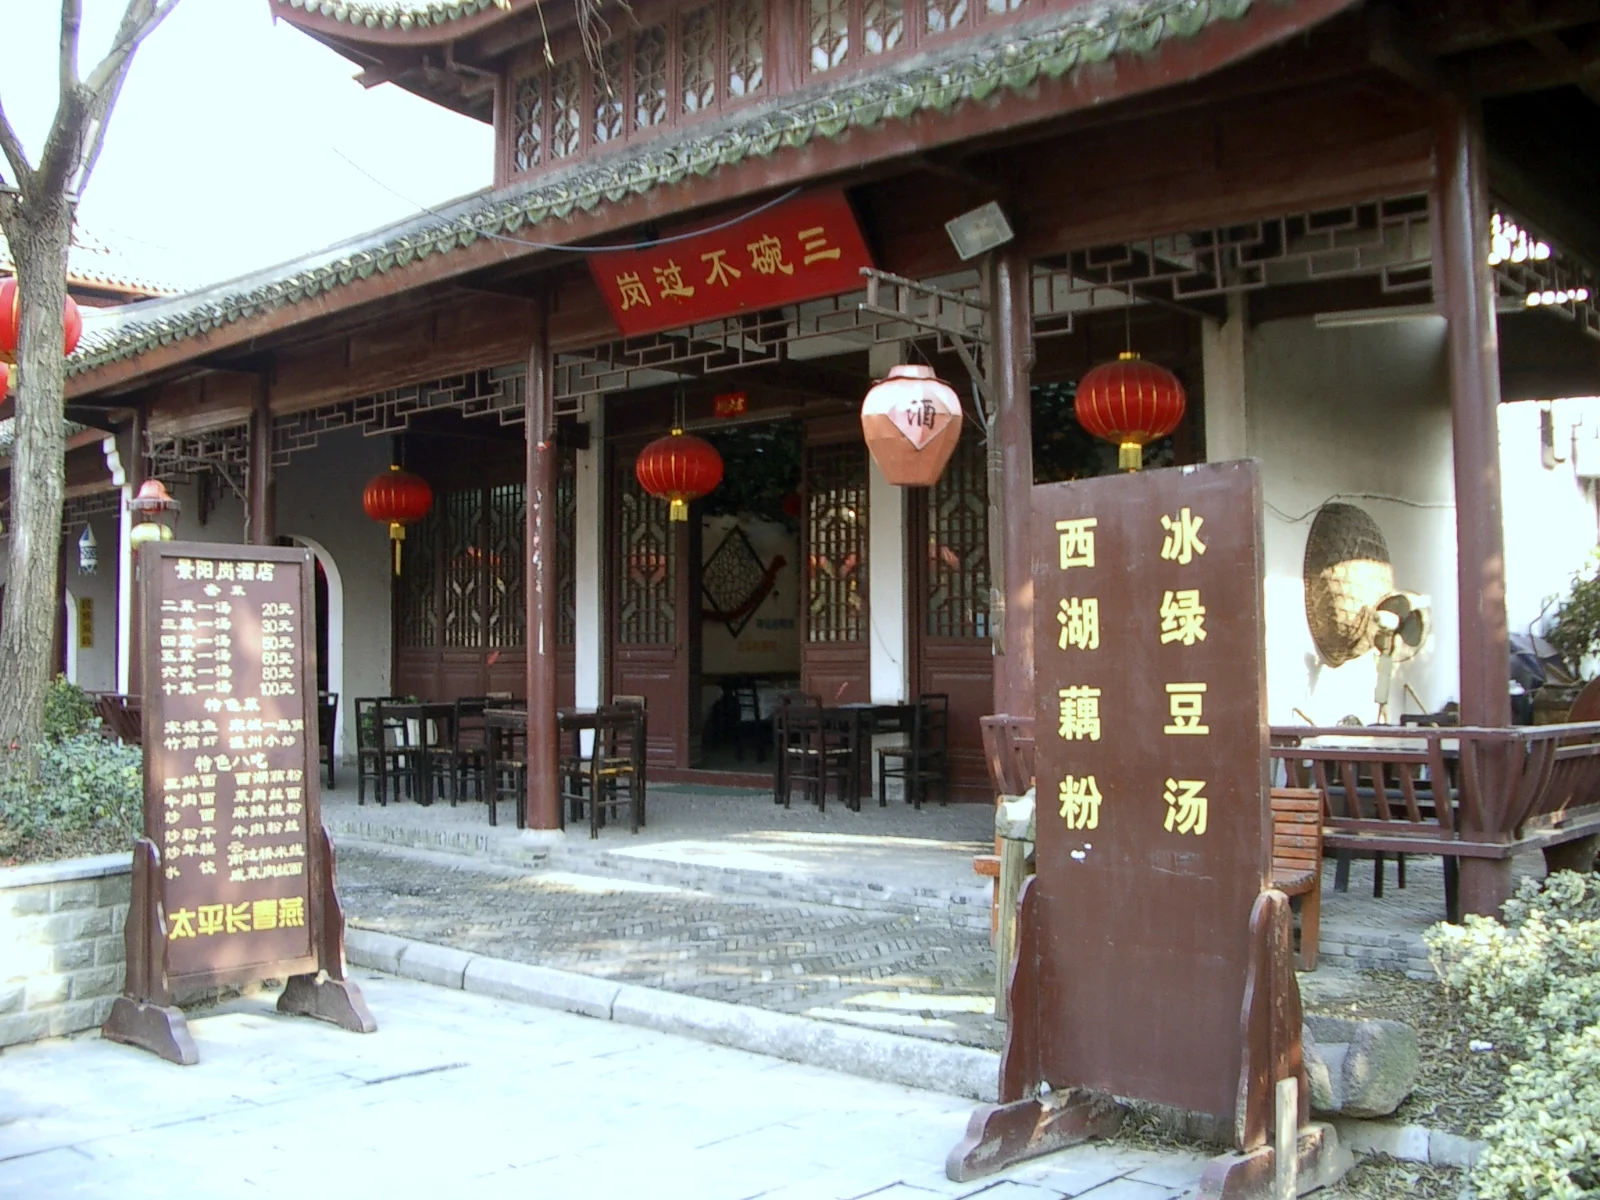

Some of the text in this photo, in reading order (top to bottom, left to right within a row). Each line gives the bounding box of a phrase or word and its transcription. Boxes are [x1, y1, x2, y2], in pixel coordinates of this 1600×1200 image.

[615, 226, 841, 310] 三碗不过岗
[906, 398, 936, 430] 酒
[174, 558, 276, 582] 景阳岗酒店
[160, 599, 295, 617] 二菜一汤 20元
[160, 616, 295, 634] 三菜一汤 30元
[160, 634, 232, 648] 四菜一汤
[160, 649, 295, 666] 五菜一汤 60元
[161, 664, 295, 681] 六菜一汤 80元
[1055, 517, 1103, 830] 西湖藕粉
[1159, 507, 1210, 835] 冰绿豆汤
[161, 680, 296, 697] 十菜一汤 100元
[203, 697, 261, 713] 特色菜
[164, 791, 217, 809] 牛肉面
[230, 818, 301, 838] 牛肉粉丝
